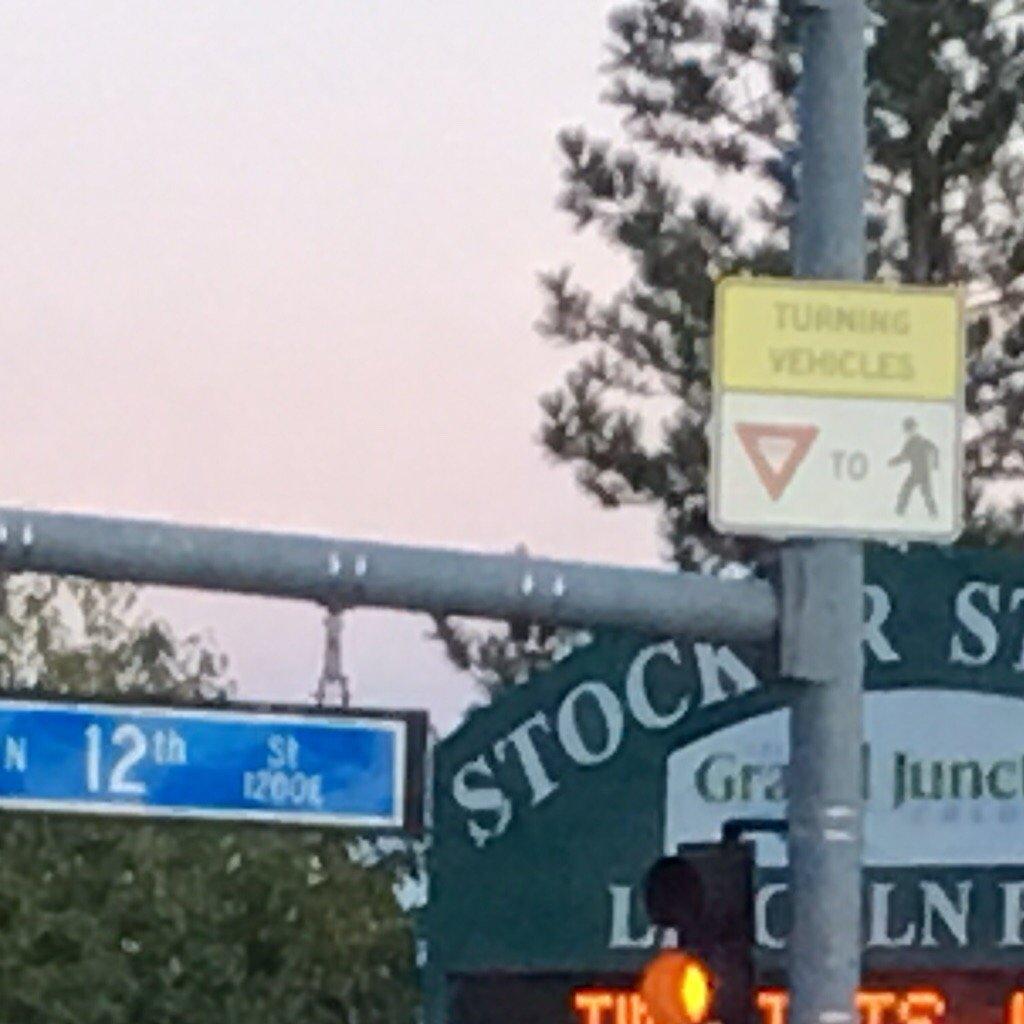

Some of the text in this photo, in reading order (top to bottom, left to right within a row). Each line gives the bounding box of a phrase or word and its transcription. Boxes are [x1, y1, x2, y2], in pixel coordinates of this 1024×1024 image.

[772, 301, 912, 335] TURNING
[769, 347, 916, 379] VEHICLES
[830, 450, 868, 481] TO
[452, 584, 900, 848] STOCKR
[5, 723, 299, 794] N 12th St
